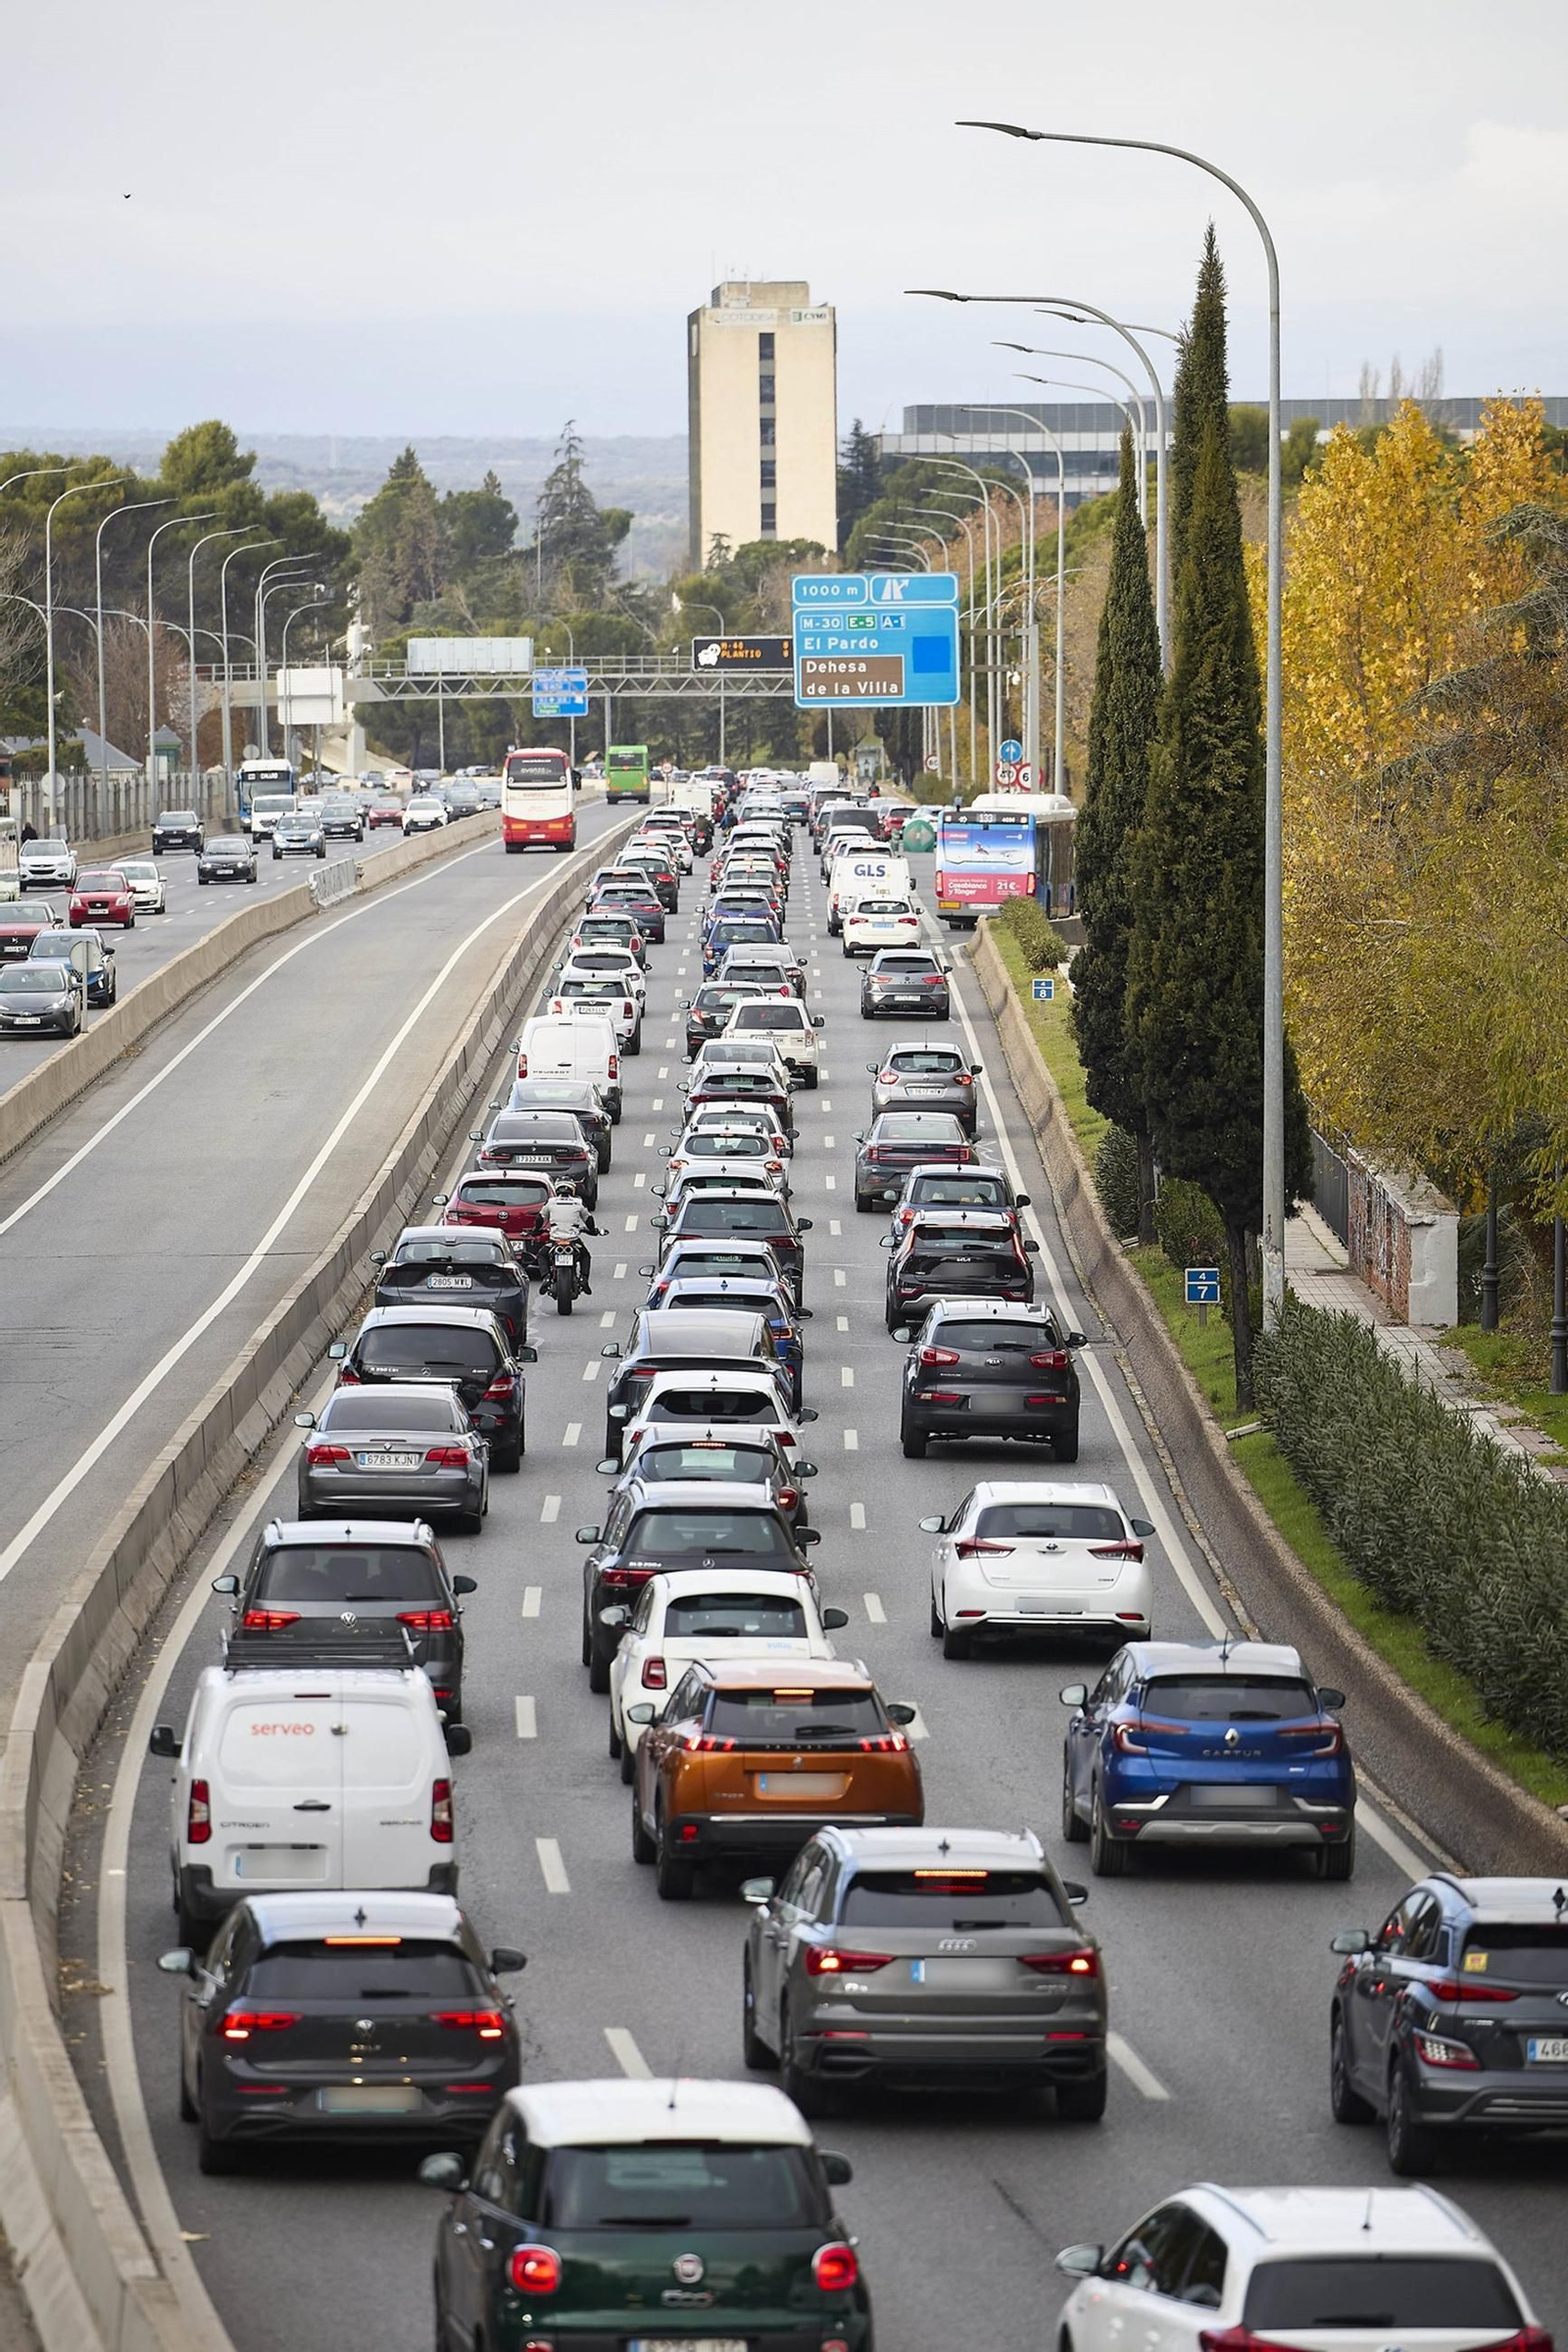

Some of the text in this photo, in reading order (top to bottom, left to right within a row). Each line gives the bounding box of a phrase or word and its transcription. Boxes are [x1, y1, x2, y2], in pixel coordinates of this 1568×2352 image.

[803, 585, 858, 596] 1000 m
[803, 617, 841, 628] M-30
[849, 616, 875, 628] E-5
[883, 615, 906, 627] A-1
[804, 636, 879, 650] El Pardo
[806, 661, 867, 673] Dehesa
[806, 681, 899, 695] de la Villa
[1023, 770, 1030, 782] 6
[1039, 989, 1047, 999] 8
[1198, 1272, 1206, 1281] 4
[1197, 1286, 1208, 1299] 7
[368, 1454, 414, 1465] 6783 KJN
[251, 1722, 316, 1737] serveo
[1201, 1748, 1262, 1758] CAPTUR
